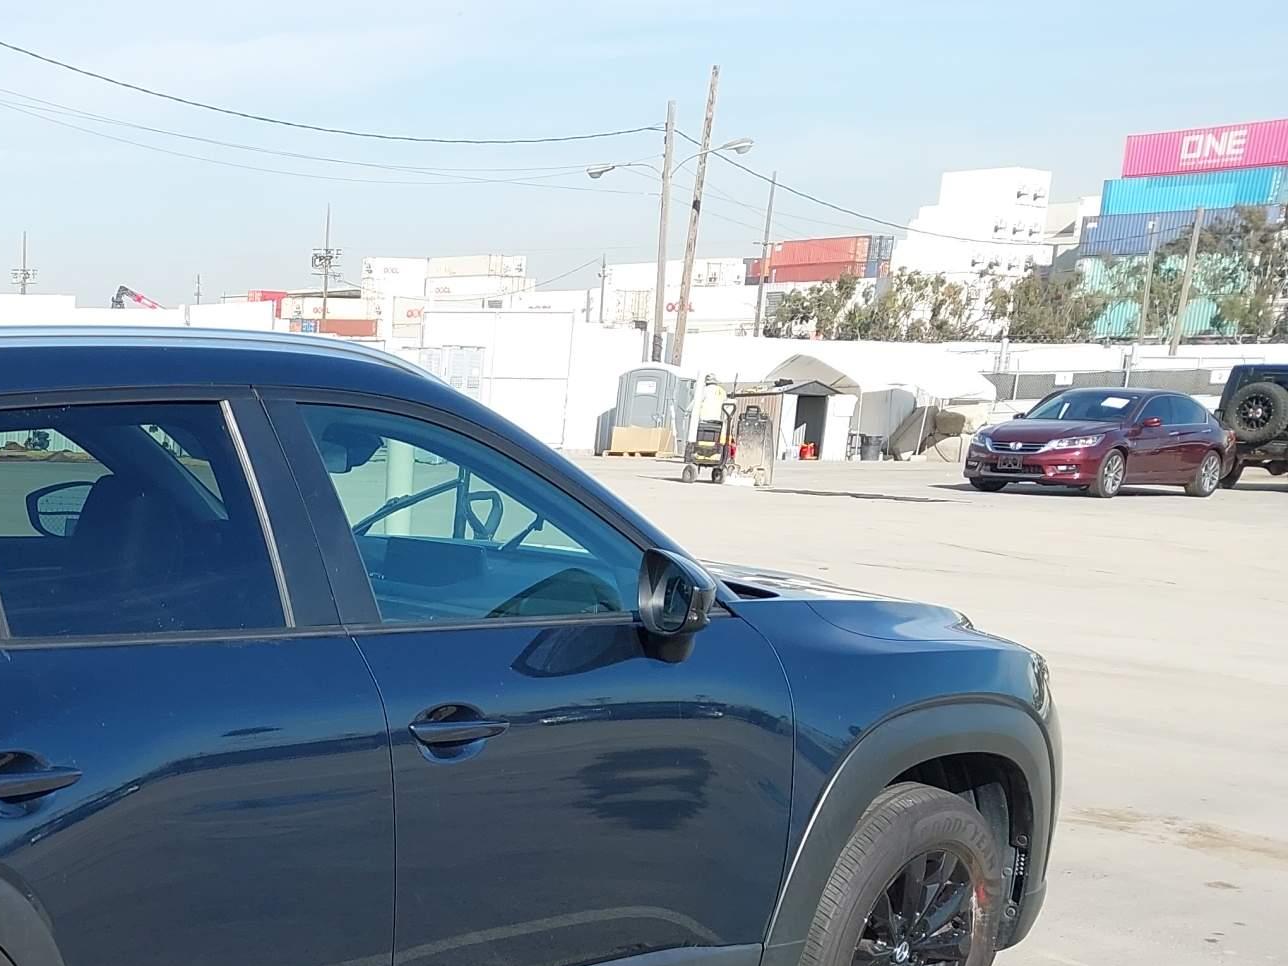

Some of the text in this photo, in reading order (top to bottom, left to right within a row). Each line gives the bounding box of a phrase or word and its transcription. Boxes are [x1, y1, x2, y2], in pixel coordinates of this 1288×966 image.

[1180, 128, 1248, 159] ONE
[312, 306, 331, 314] OOL
[666, 302, 695, 312] OOL
